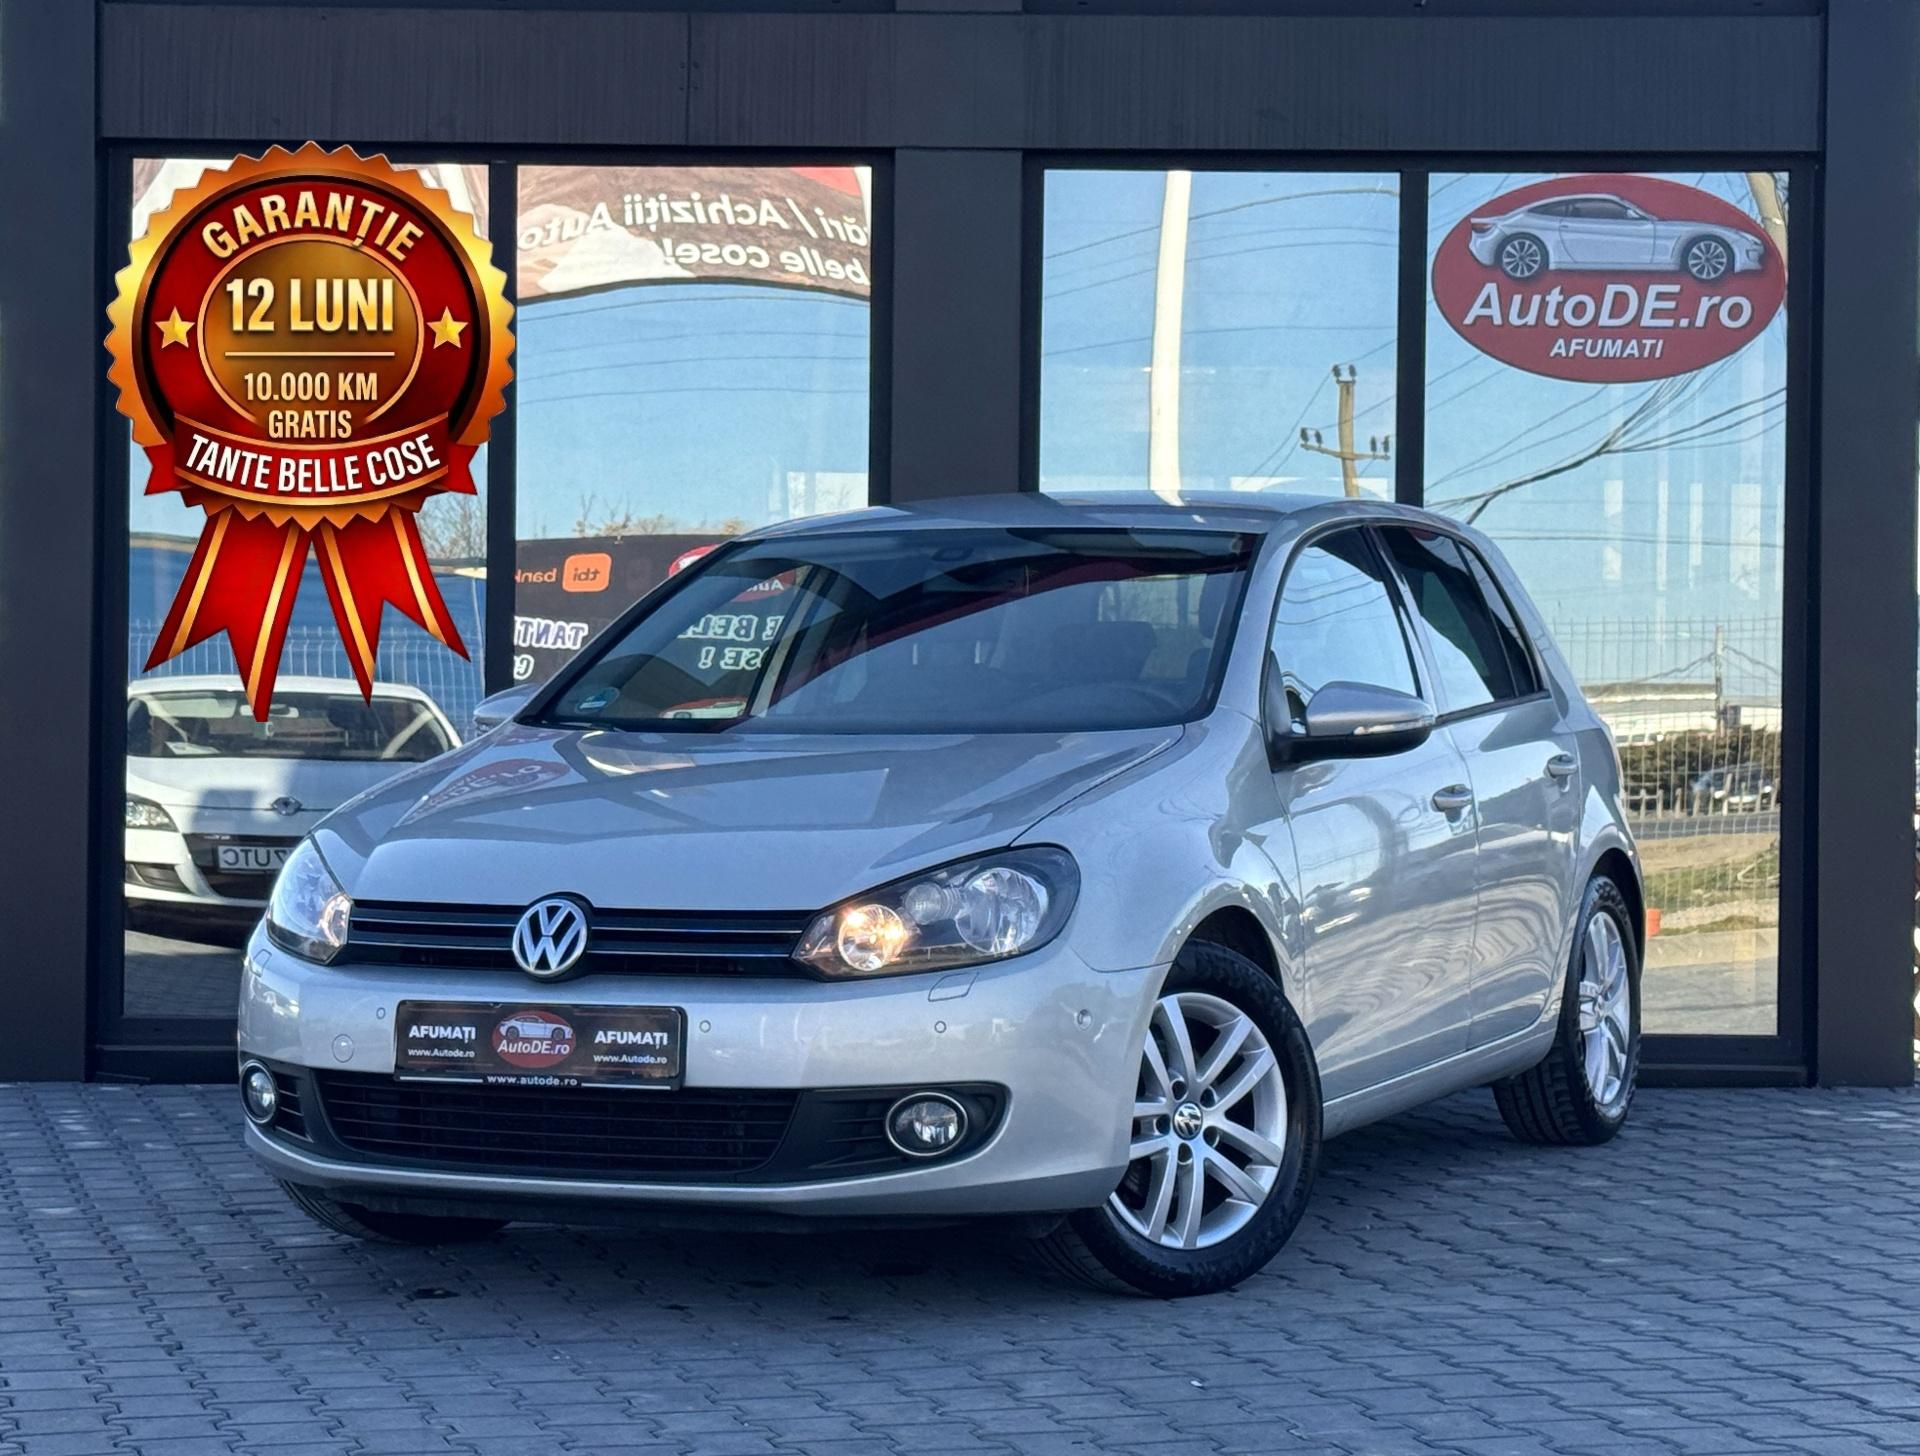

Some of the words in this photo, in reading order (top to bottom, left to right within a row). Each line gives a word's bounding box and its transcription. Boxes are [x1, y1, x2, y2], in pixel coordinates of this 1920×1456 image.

[1463, 282, 1752, 329] AutoDE.ro
[1550, 338, 1664, 359] AFUMATI
[497, 1039, 570, 1056] AutoDE.ro
[487, 1074, 578, 1086] www.autode.ro
